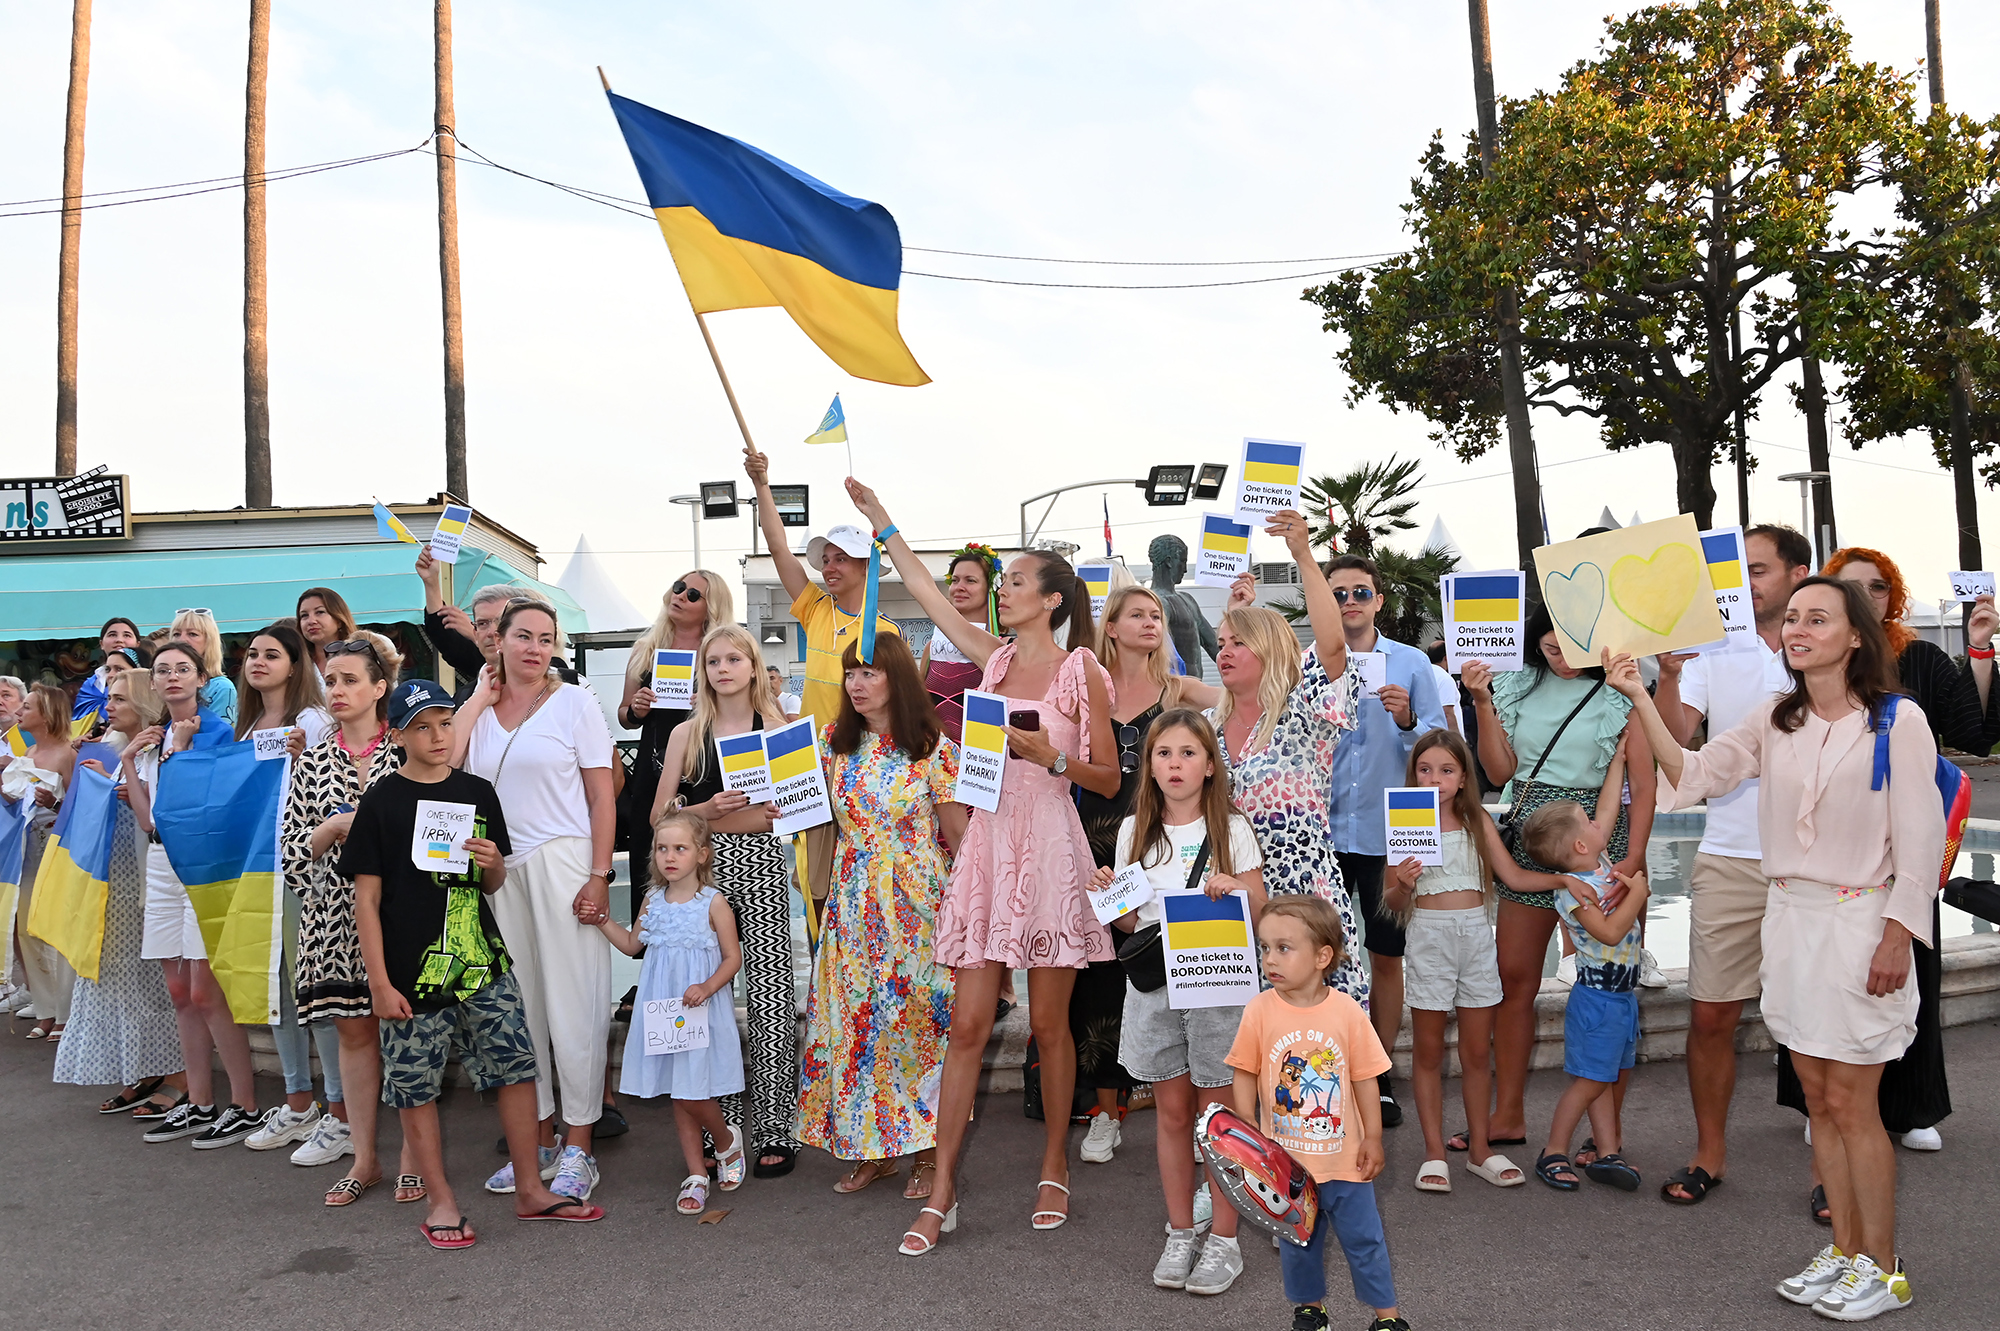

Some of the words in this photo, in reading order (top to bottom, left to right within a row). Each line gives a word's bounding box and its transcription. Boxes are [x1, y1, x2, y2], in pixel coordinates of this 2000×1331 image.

[1263, 486, 1282, 494] ticket
[66, 493, 112, 510] CROISETTE
[1243, 494, 1292, 507] OHTYRKA
[77, 502, 102, 513] 2000
[1218, 554, 1234, 562] ticket
[1210, 561, 1235, 571] IRPIN
[1954, 584, 1994, 597] BUCHA
[1458, 626, 1476, 634] One
[1479, 626, 1502, 634] ticket
[1457, 637, 1515, 647] OHTYRKA
[656, 686, 688, 694] OHTYRKA
[966, 752, 978, 761] One
[979, 754, 993, 765] ticket
[994, 758, 999, 766] to
[742, 770, 758, 778] ticket
[965, 764, 997, 781] KHARKIV
[731, 776, 766, 790] KHARKIV
[776, 786, 789, 794] One
[790, 779, 808, 790] ticket
[775, 786, 822, 808] MARIUPOL
[427, 810, 444, 819] ONE
[447, 812, 469, 822] TICKET
[1389, 838, 1438, 846] GOSTOMEL
[1098, 882, 1139, 908] GOSTOMEL
[1177, 954, 1198, 963] One
[1201, 953, 1230, 961] ticket
[1233, 953, 1244, 961] to
[1171, 965, 1252, 977] BORODYANKA
[1176, 979, 1250, 989] #filmforfreeukraine
[648, 1026, 706, 1046] BUCHA
[1269, 1030, 1302, 1064] ALWAYS
[1307, 1030, 1324, 1043] ON
[1324, 1037, 1345, 1066] DUTY
[1273, 1112, 1303, 1128] PAW
[1274, 1126, 1303, 1138] PATROL
[1274, 1136, 1323, 1151] ADVENTURE
